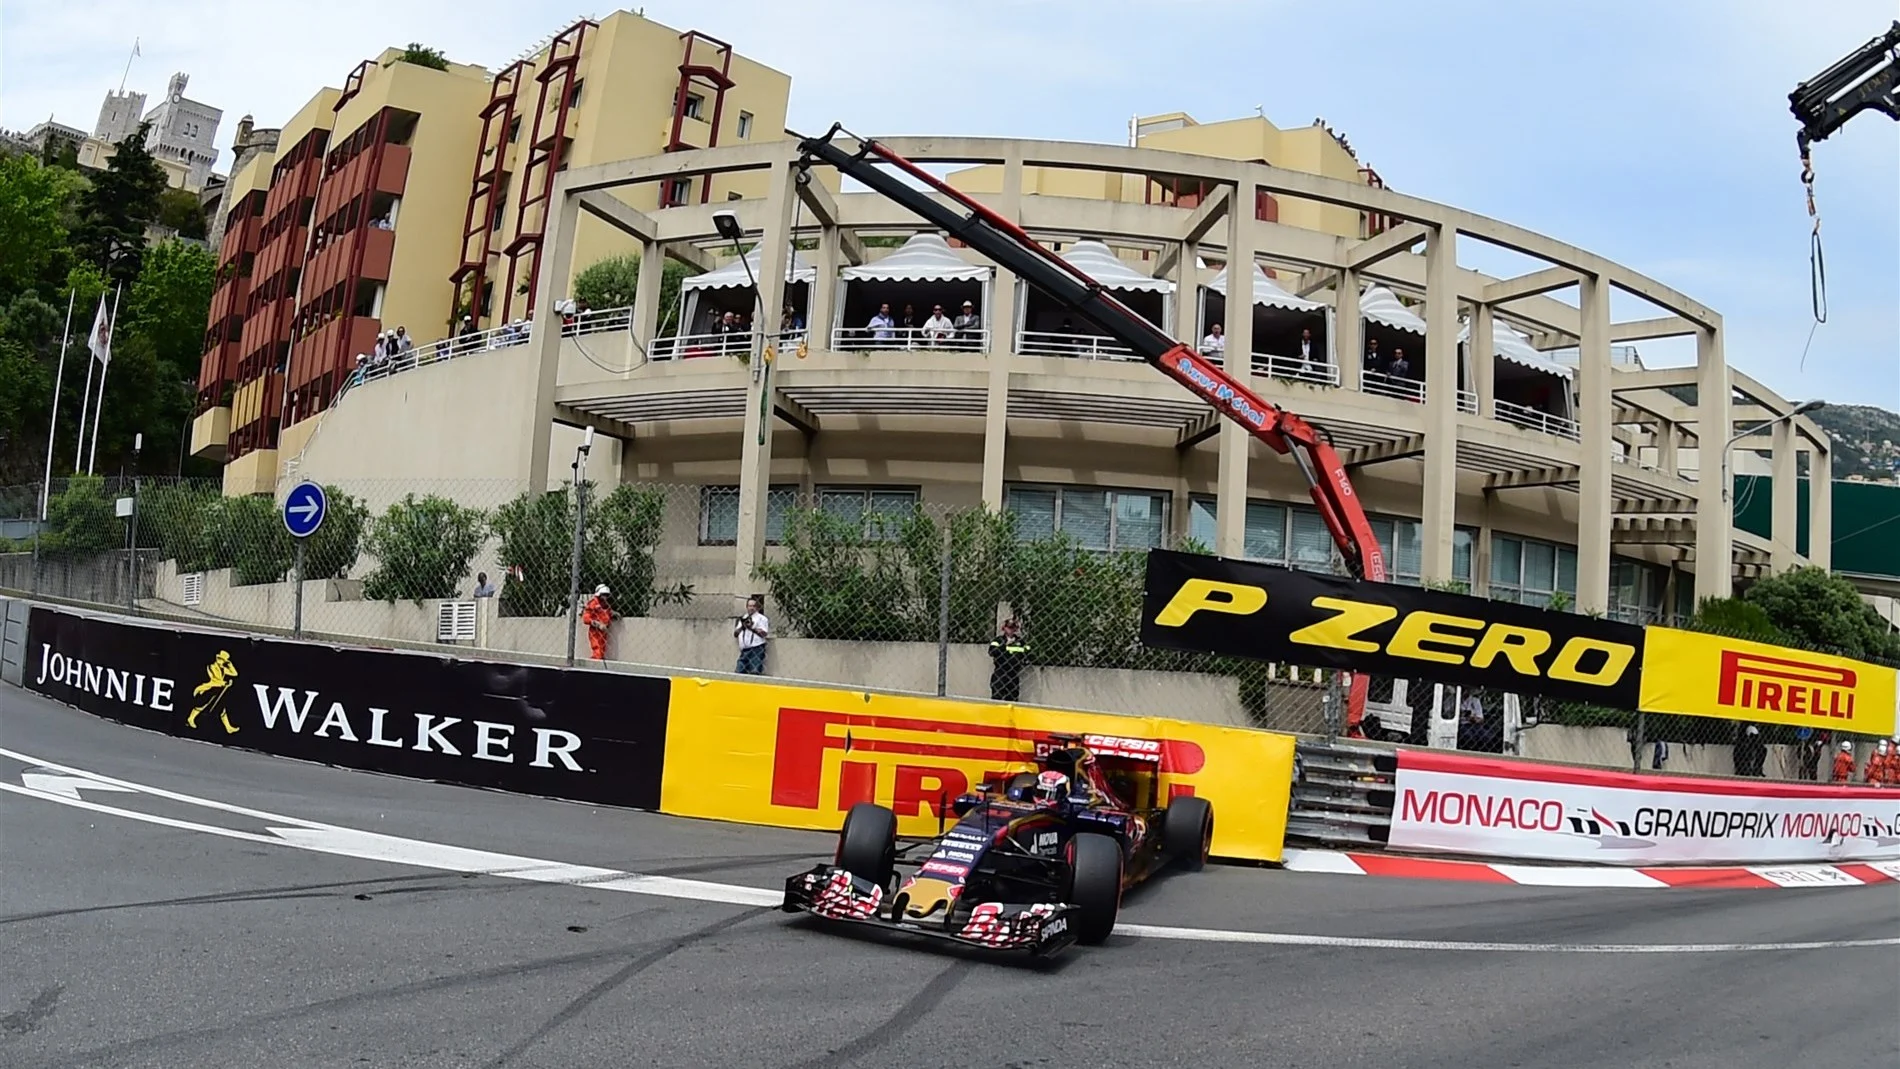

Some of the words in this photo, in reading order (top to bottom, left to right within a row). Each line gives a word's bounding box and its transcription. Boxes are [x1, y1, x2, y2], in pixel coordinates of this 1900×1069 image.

[1176, 358, 1217, 391] Azur
[1154, 578, 1268, 627] P
[1289, 597, 1636, 687] ZERO
[37, 643, 175, 712] JOHNNIE
[253, 683, 584, 772] WALKER
[1718, 650, 1857, 720] PIRELLI
[1089, 735, 1159, 752] CEPSA
[1401, 789, 1563, 832] MONACO
[1634, 808, 1779, 839] GRANDPRIX
[1781, 812, 1862, 839] MONACO
